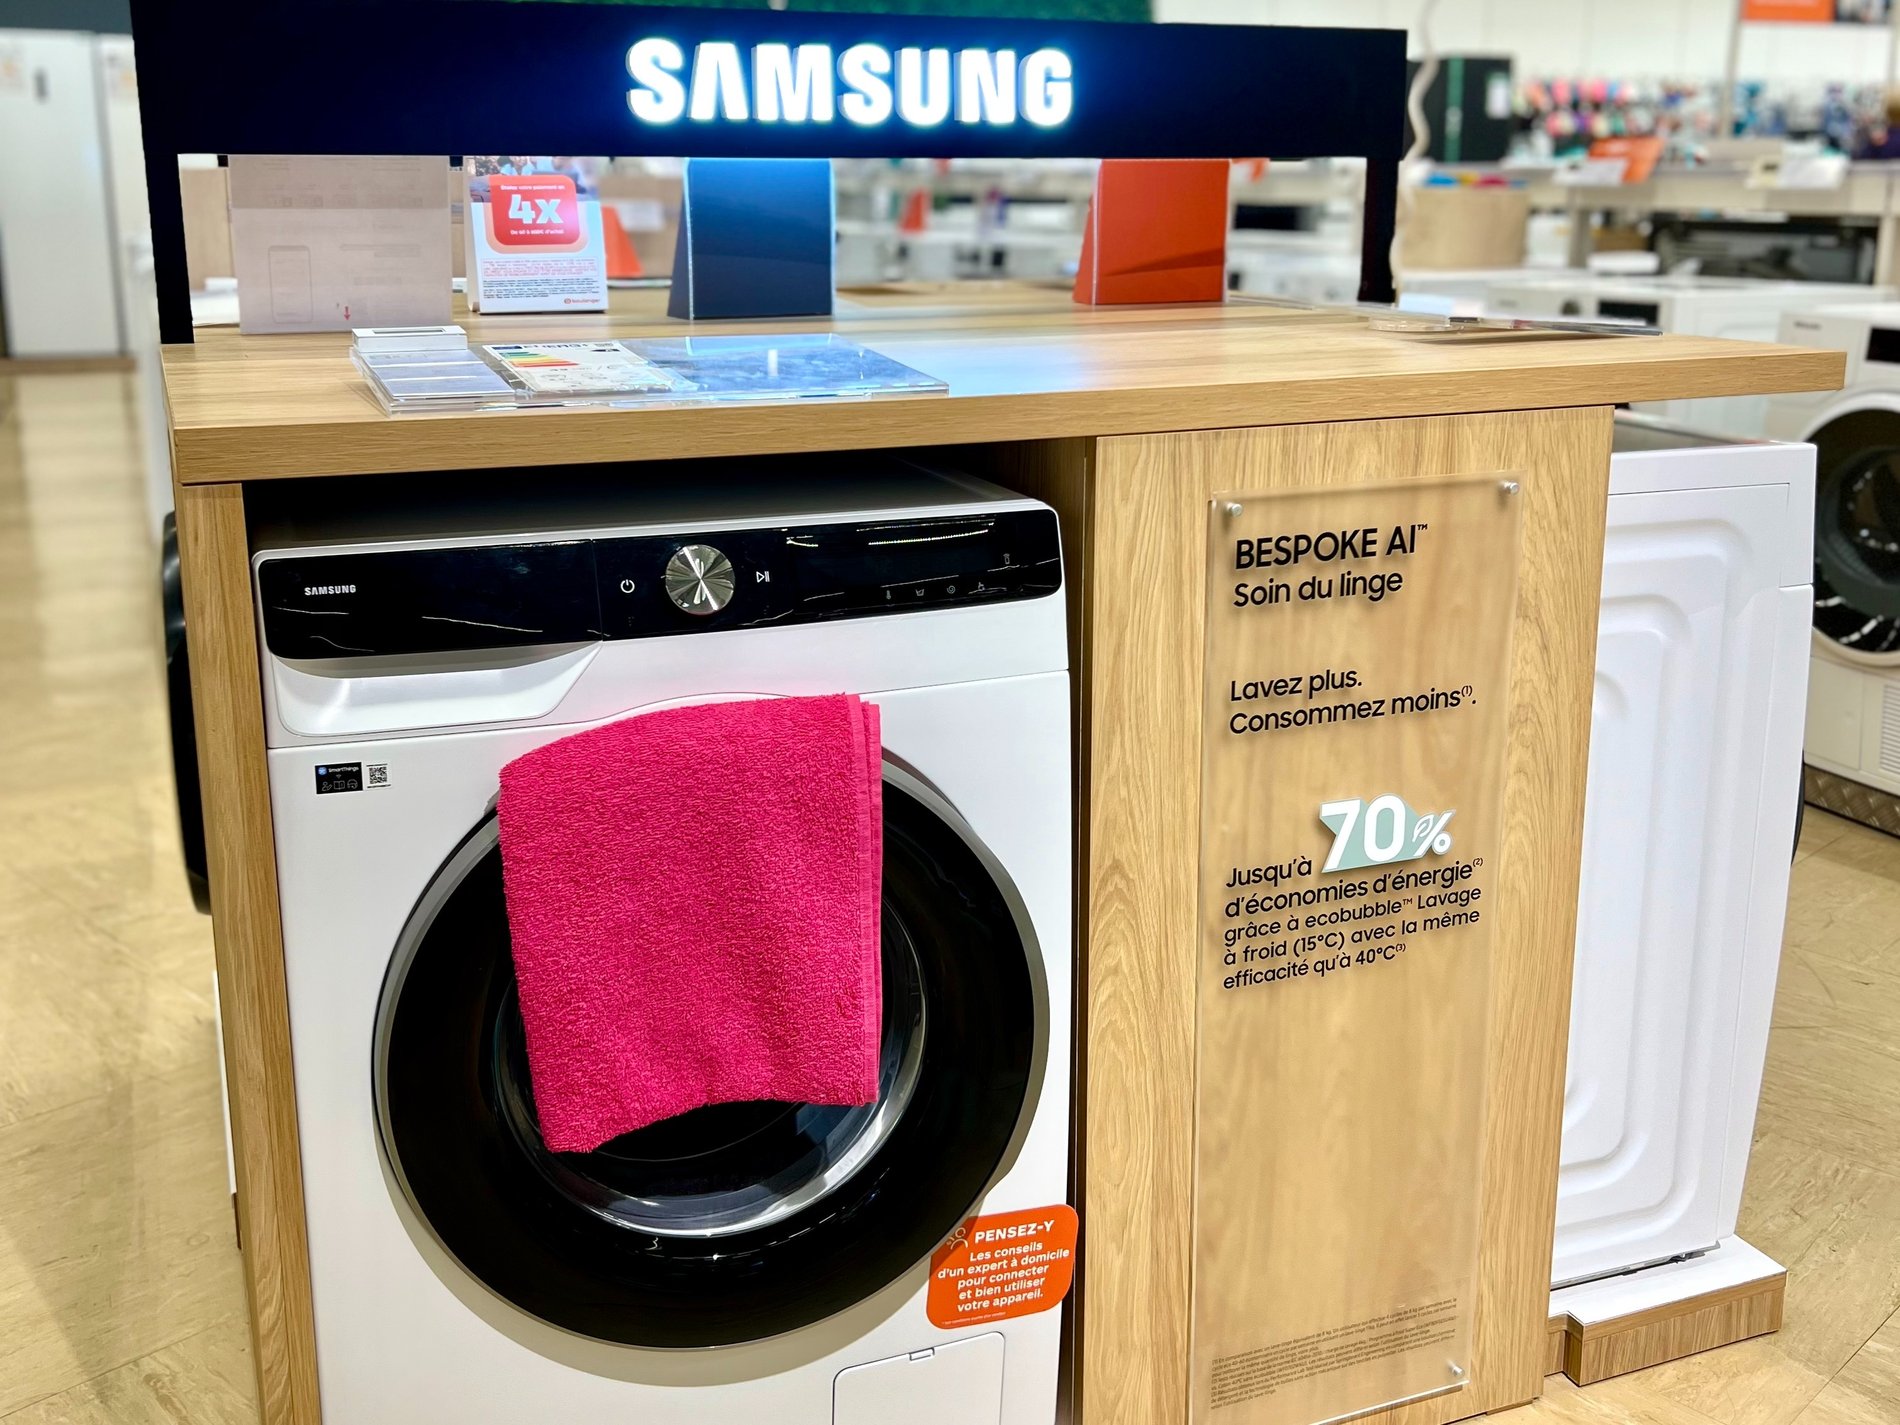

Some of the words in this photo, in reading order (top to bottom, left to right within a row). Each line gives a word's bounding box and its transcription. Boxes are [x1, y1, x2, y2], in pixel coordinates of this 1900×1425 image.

[625, 37, 1073, 127] SAMSUNG
[1235, 529, 1379, 570] BESPOKE
[304, 584, 357, 596] SAMSUNG
[1233, 577, 1292, 608] Soin
[1297, 577, 1333, 602] du
[1339, 570, 1404, 602] linge
[1230, 676, 1303, 702] Lavez
[1308, 668, 1363, 699] plus.
[1229, 699, 1385, 735] Consommez
[1225, 857, 1313, 888] Jusqu'à
[1224, 878, 1369, 919] d'économies
[1223, 919, 1282, 947] grâce
[1286, 911, 1301, 931] à
[1417, 886, 1483, 915] Lavage
[1223, 947, 1237, 966] à
[1243, 937, 1288, 963] froid
[1292, 932, 1346, 959] (15°C)
[1350, 924, 1396, 945] avec
[1400, 920, 1418, 935] la
[1422, 909, 1481, 931] même
[1223, 960, 1309, 991] efficacité
[1313, 951, 1352, 976] qu'à
[975, 1220, 1055, 1243] PENSEZ-Y
[938, 1268, 964, 1279] d'un
[968, 1262, 1008, 1276] expert
[1010, 1258, 1018, 1268] à
[1021, 1248, 1070, 1265] domicile
[970, 1252, 991, 1262] Les
[994, 1242, 1043, 1258] conseils
[958, 1276, 986, 1290] pour
[989, 1265, 1049, 1283] connecter
[959, 1290, 972, 1300] et
[975, 1285, 1001, 1297] bien
[1004, 1277, 1046, 1292] utiliser
[957, 1298, 989, 1312] votre
[993, 1290, 1043, 1307] appareil.
